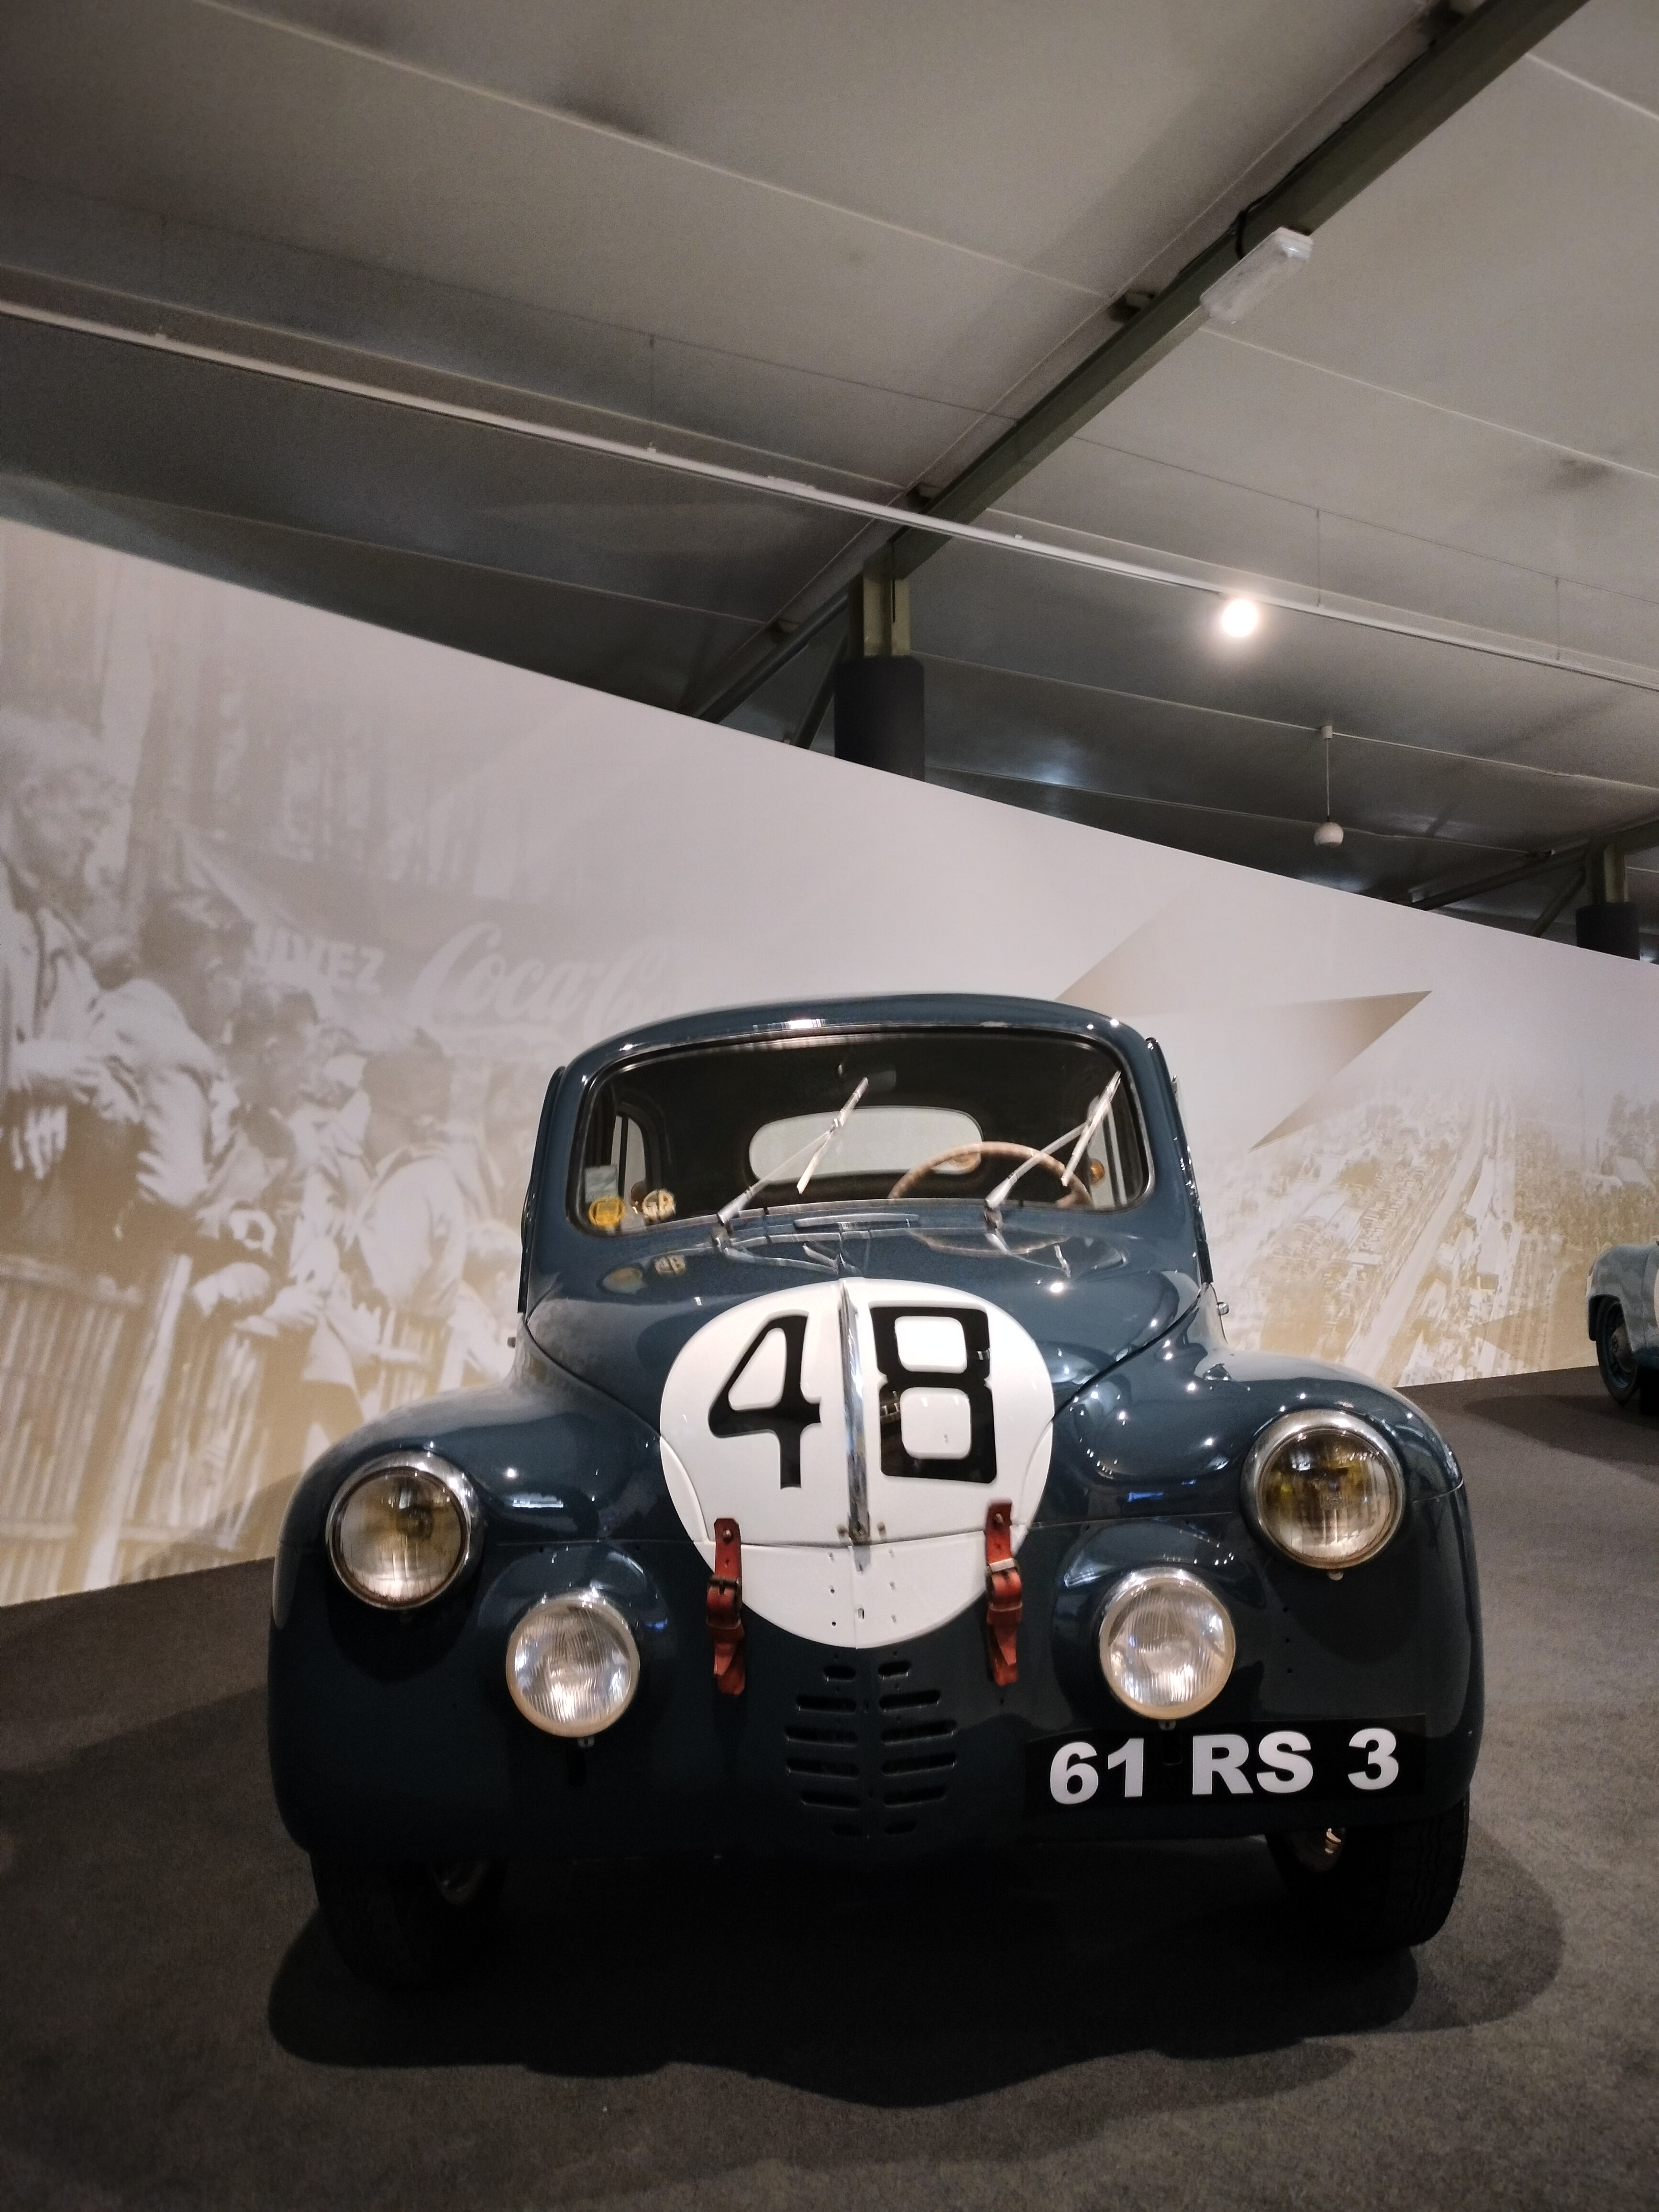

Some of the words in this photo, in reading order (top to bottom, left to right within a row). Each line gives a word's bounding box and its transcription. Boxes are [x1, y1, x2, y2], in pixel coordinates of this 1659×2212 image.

[708, 1305, 997, 1490] 48
[1050, 1738, 1144, 1804] 61
[1192, 1730, 1314, 1795] RS
[1348, 1727, 1399, 1790] 3
